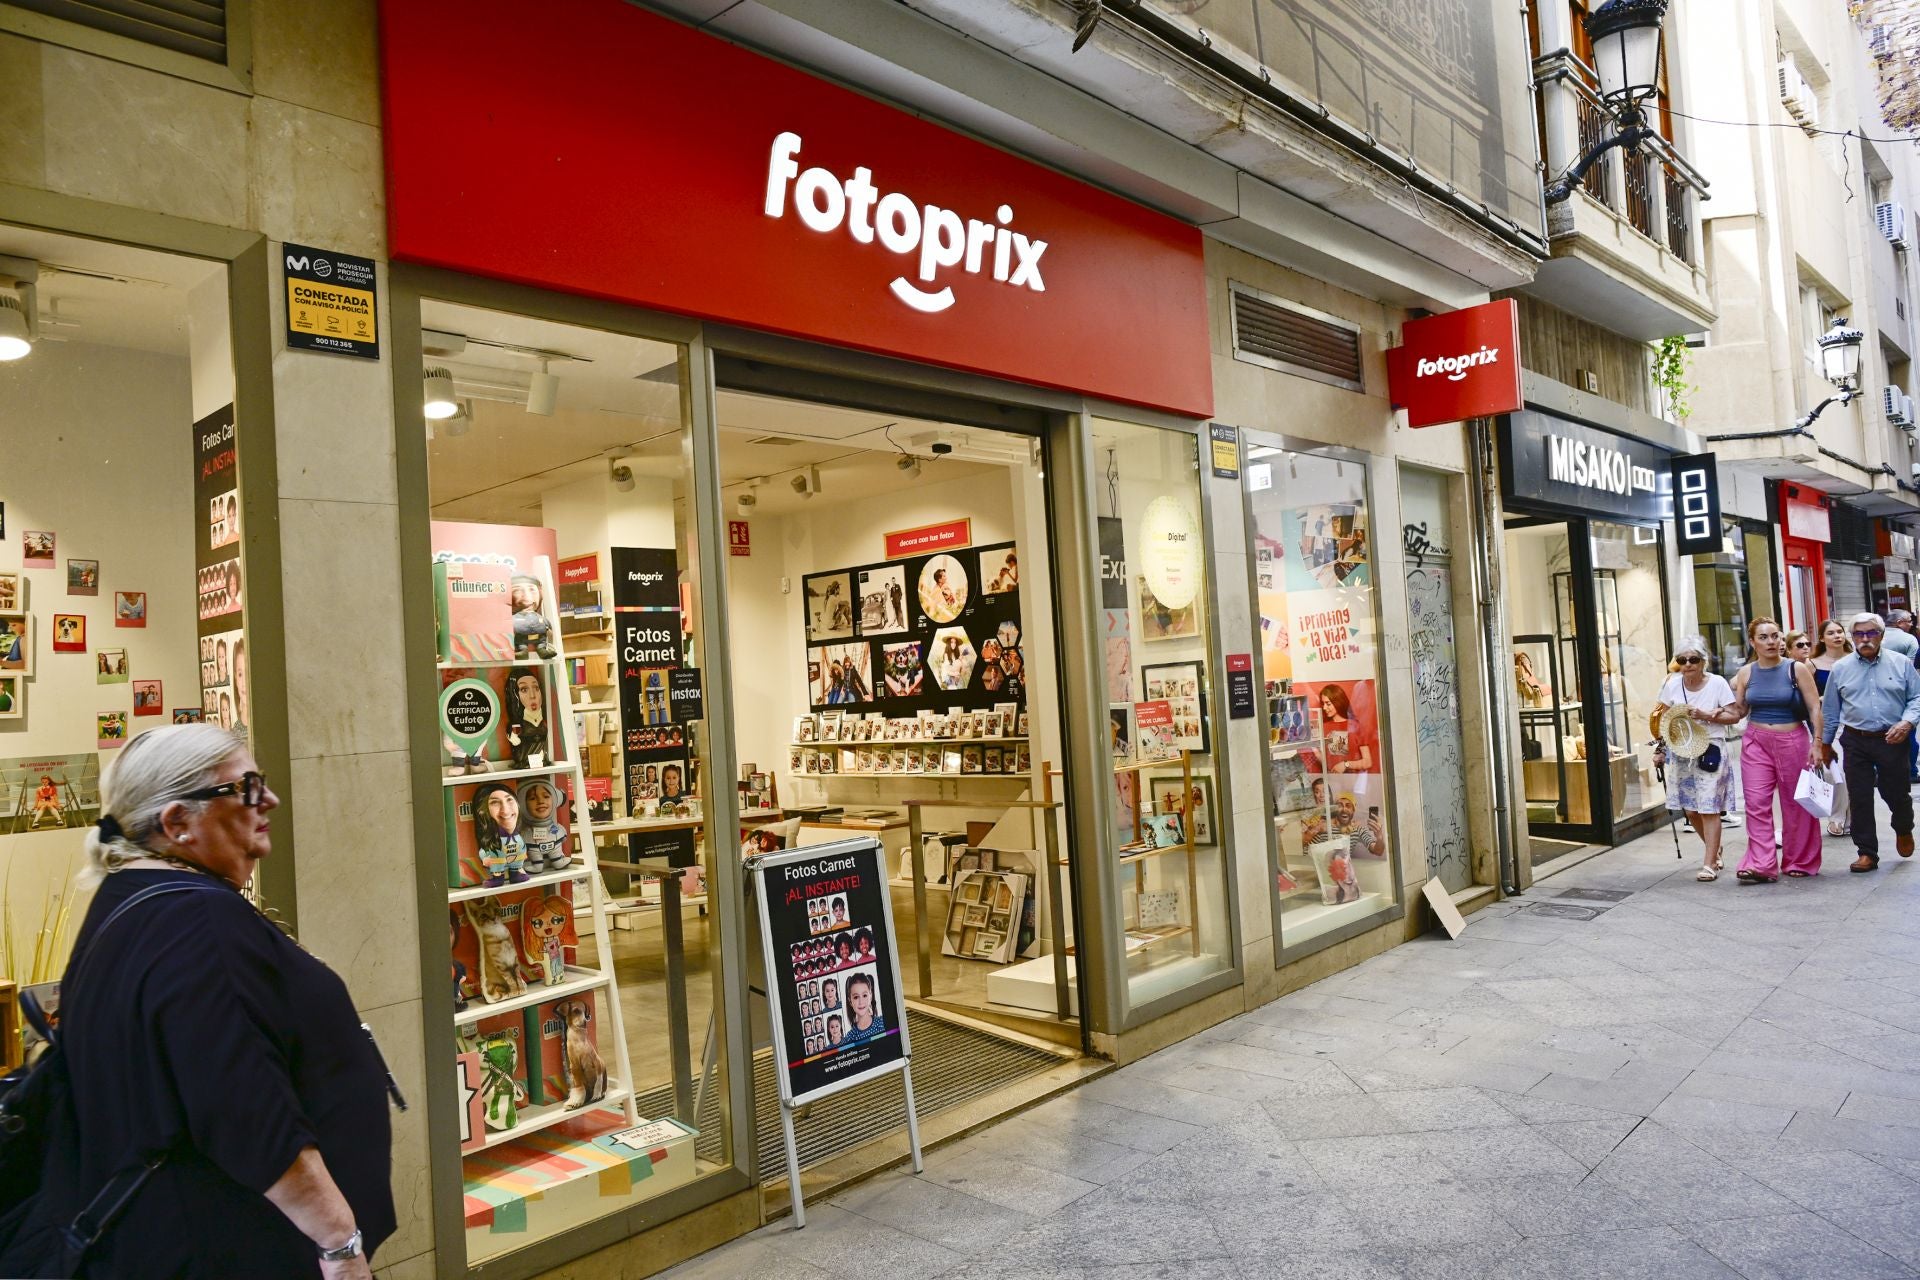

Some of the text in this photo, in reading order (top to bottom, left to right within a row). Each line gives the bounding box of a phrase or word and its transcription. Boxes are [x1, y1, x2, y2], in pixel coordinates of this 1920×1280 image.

[764, 131, 1048, 292] fotoprix
[337, 262, 370, 273] MOVISTAR
[337, 268, 374, 280] PROSEGUR
[338, 275, 367, 285] ALARMAS
[294, 287, 369, 307] CONECTADA
[294, 297, 311, 305] CON
[312, 300, 335, 309] AVISO
[341, 305, 369, 315] POLICÍA
[1416, 345, 1499, 378] fotoprix
[202, 431, 221, 452] Fotos
[1549, 434, 1626, 495] MISAKO
[899, 539, 918, 547] decora
[939, 531, 955, 539] fotos
[1168, 532, 1187, 543] Digital
[628, 571, 664, 583] fotoprix
[626, 627, 671, 644] Fotos
[1310, 631, 1321, 647] la
[624, 646, 676, 662] Carnet
[1319, 644, 1347, 662] loca!
[671, 687, 701, 700] instax
[448, 707, 490, 715] CERTIFICADA
[784, 856, 856, 881] Fotos Carnet
[785, 874, 862, 906] ¡AL INSTANTE!
[824, 1053, 871, 1073] www.fotoprix.com
